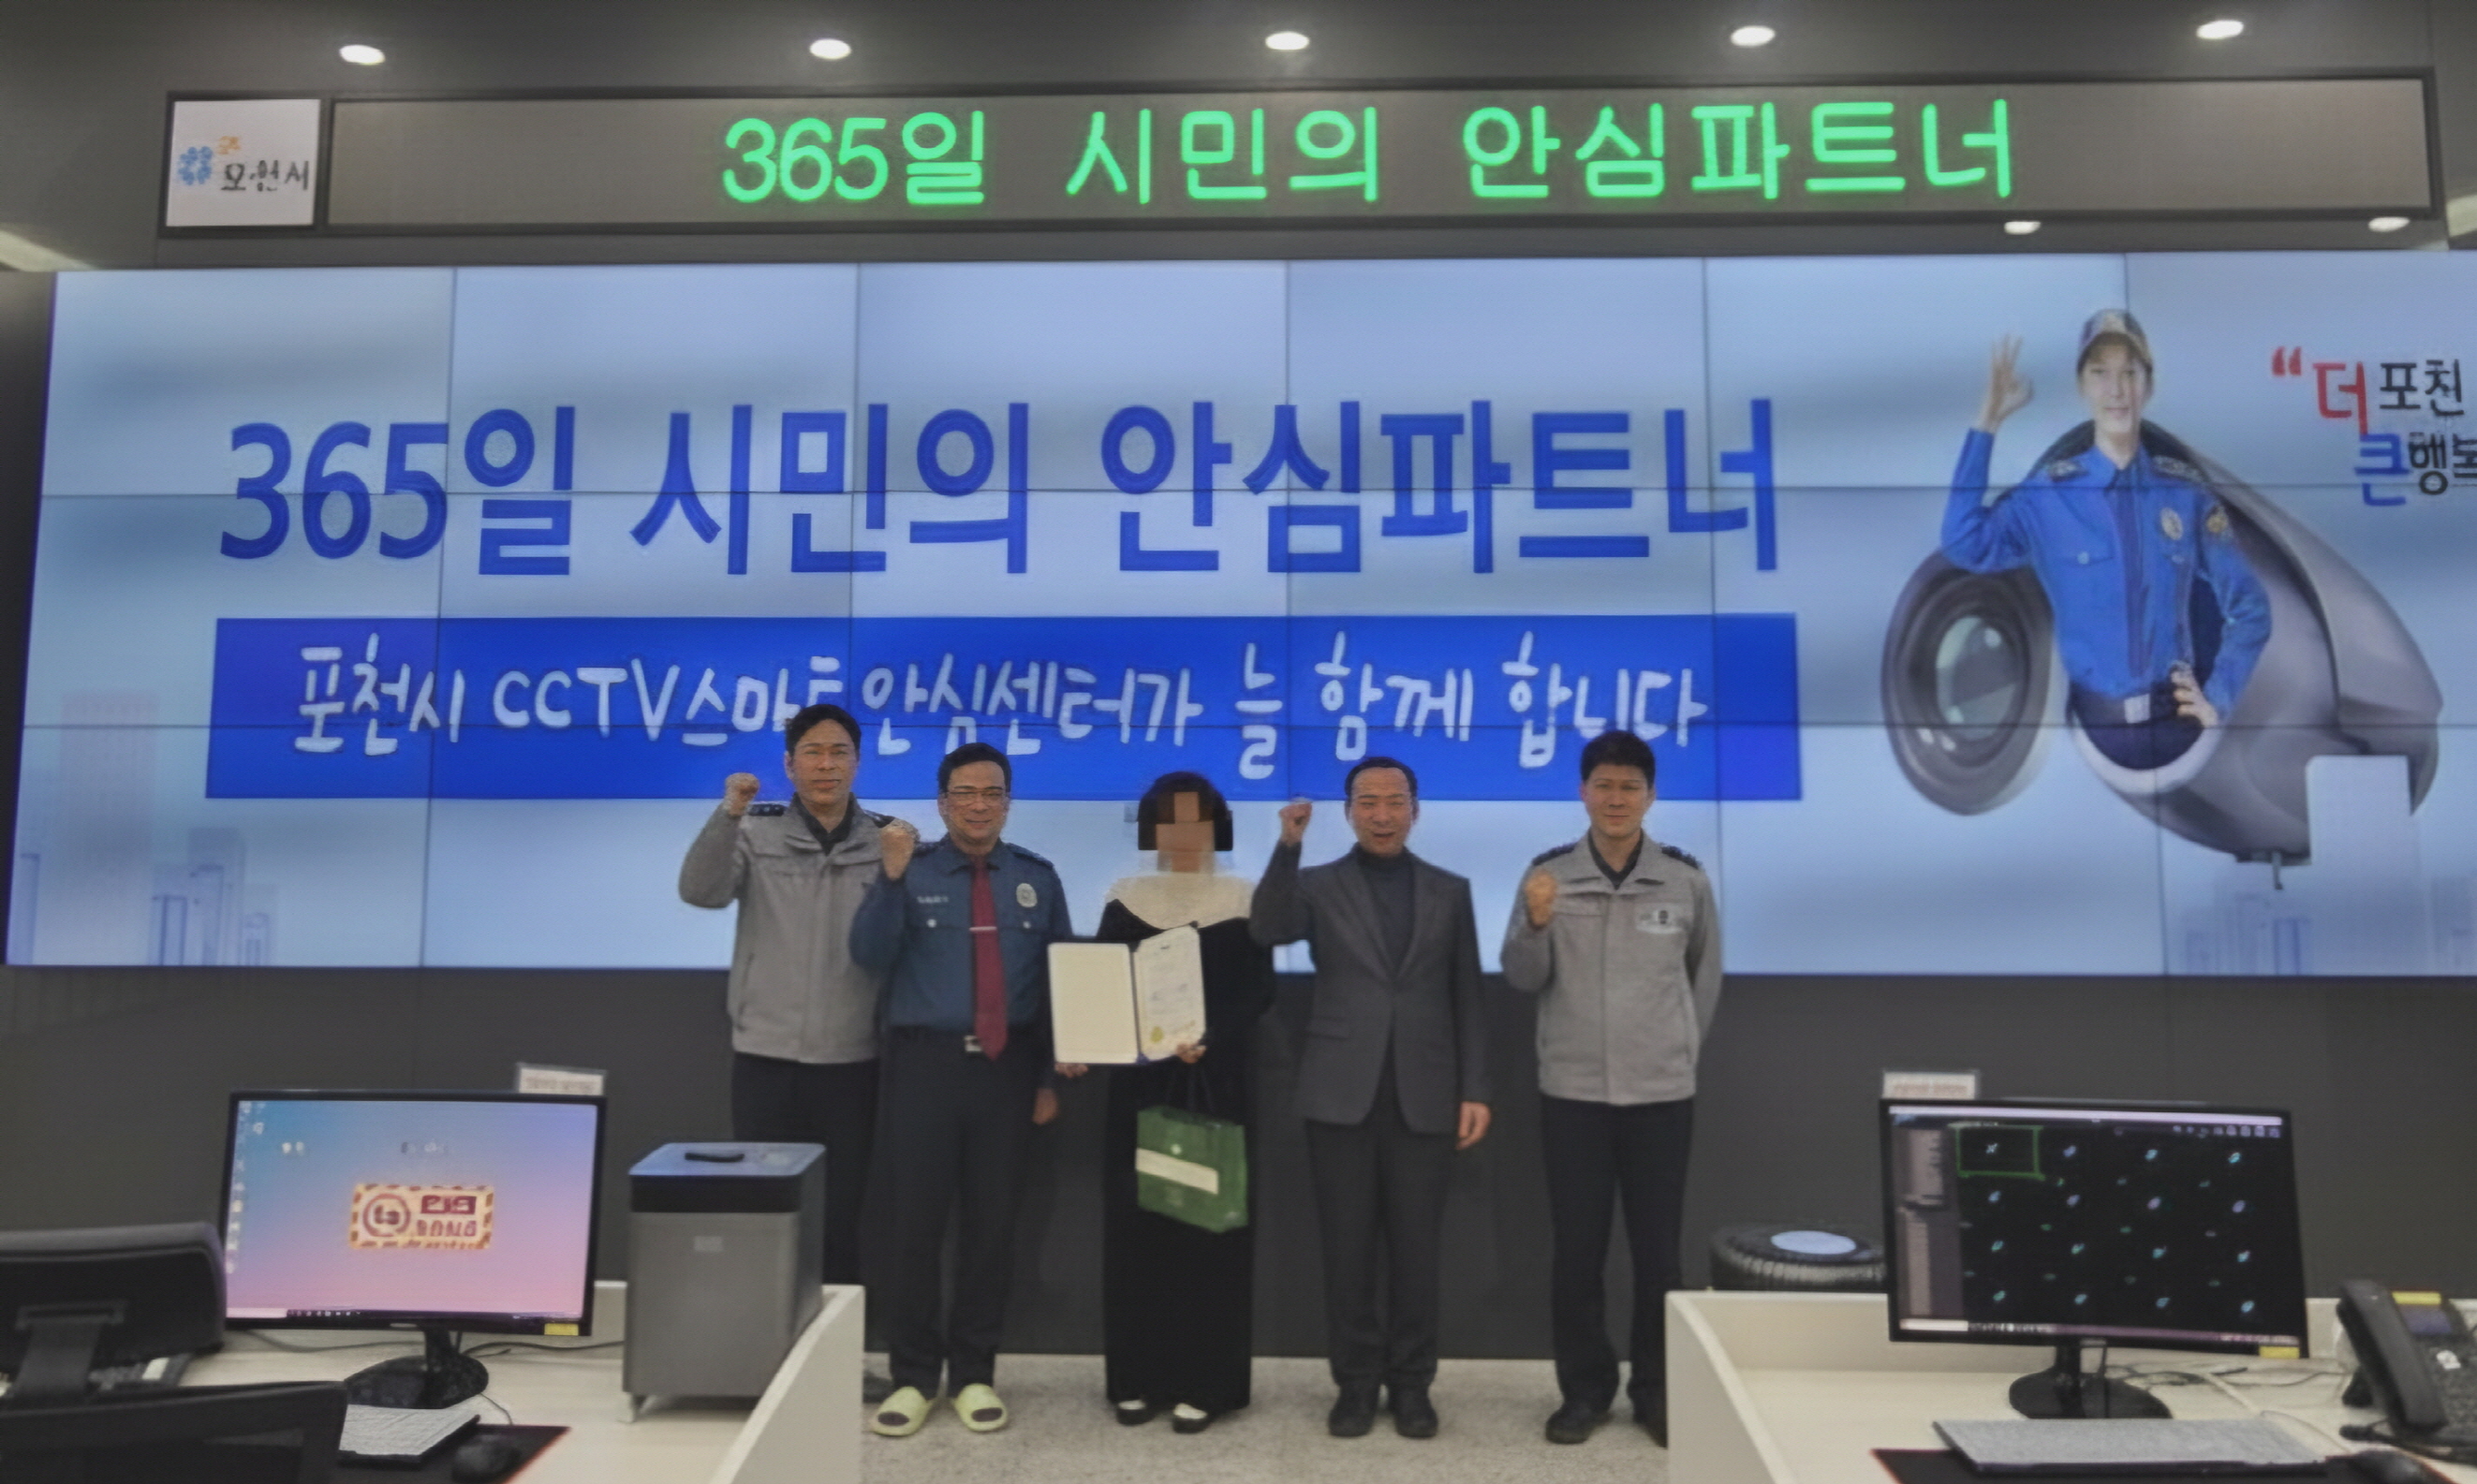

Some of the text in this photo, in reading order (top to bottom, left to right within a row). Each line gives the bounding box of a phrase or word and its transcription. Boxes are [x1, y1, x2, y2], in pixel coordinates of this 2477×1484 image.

[721, 98, 2013, 206] 365일 시민의 안심파트너
[2379, 359, 2465, 418] 포천
[220, 397, 1778, 577] 365일 시민의 안심파트너
[2353, 433, 2411, 507] 큰
[293, 633, 465, 756] 포천시
[1235, 642, 1284, 780] 늘
[1314, 630, 1475, 762] 함께
[1501, 630, 1709, 769] 합니다
